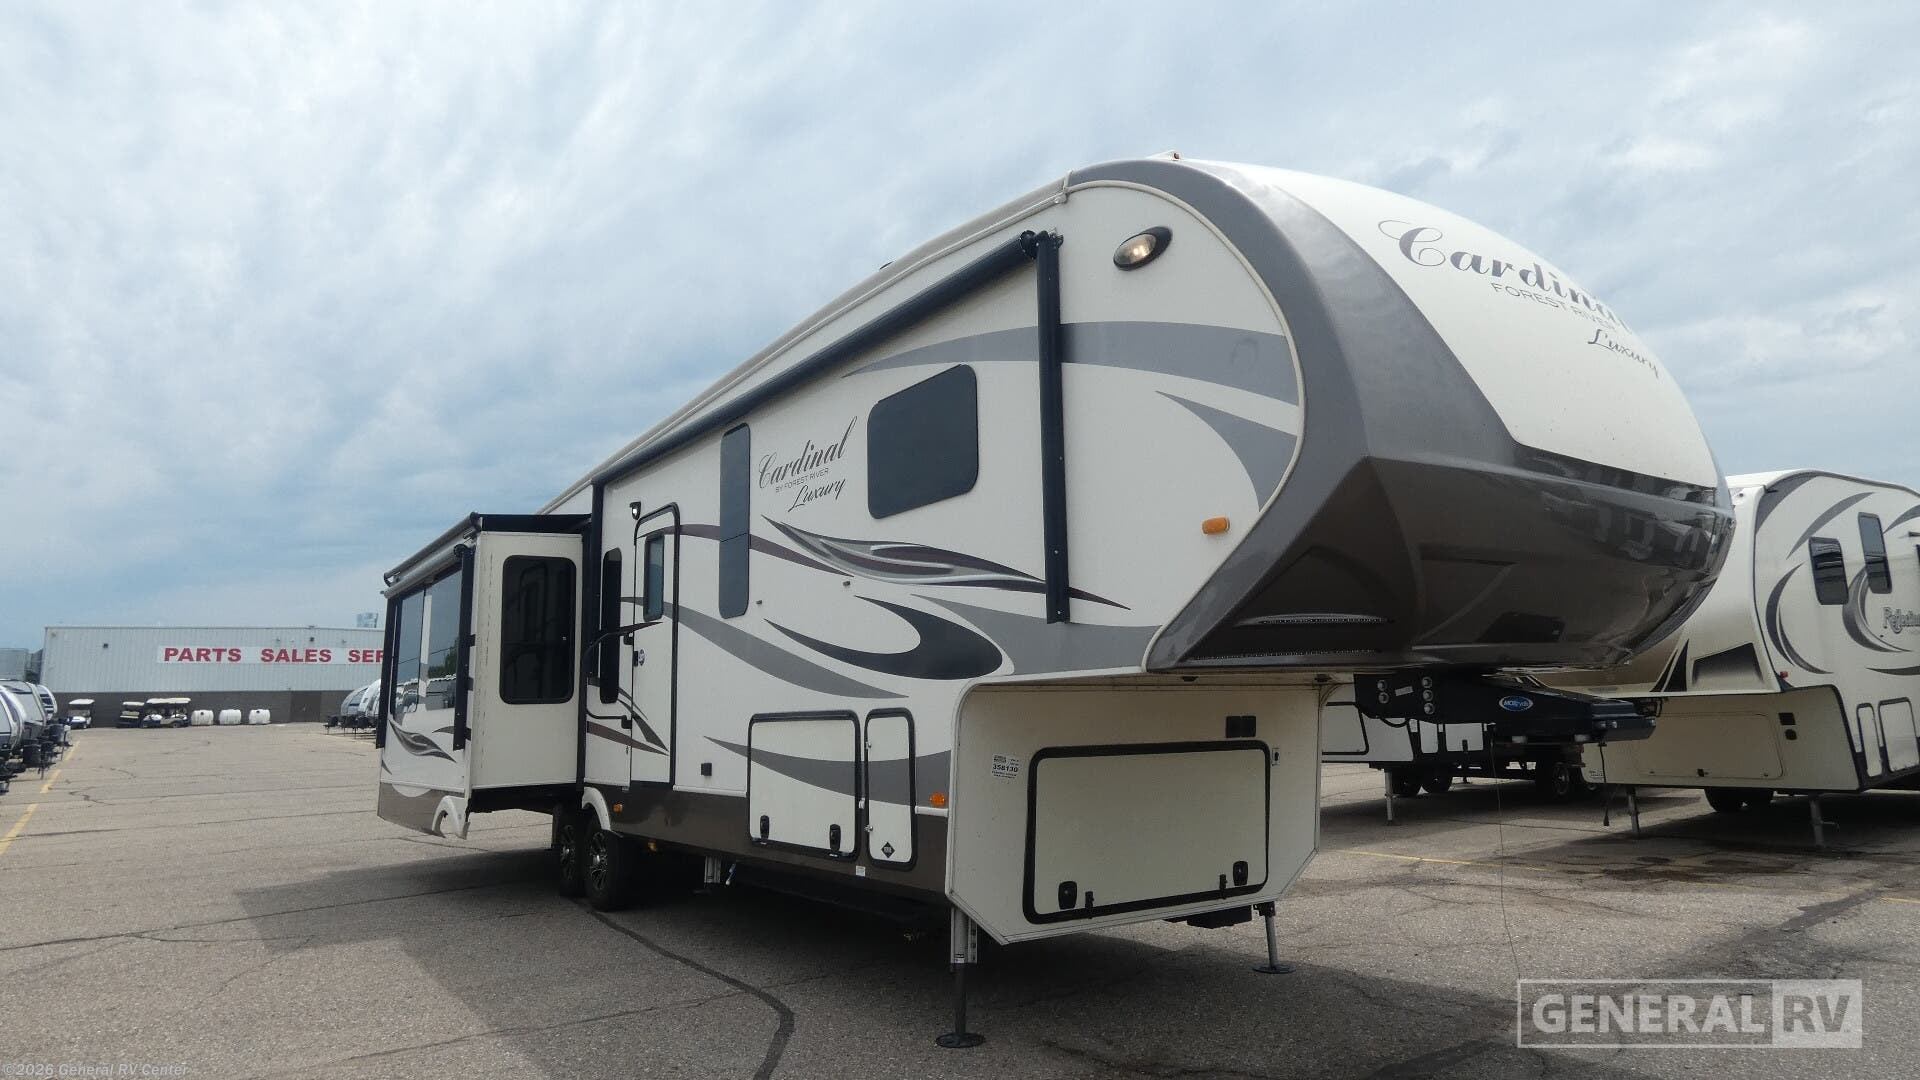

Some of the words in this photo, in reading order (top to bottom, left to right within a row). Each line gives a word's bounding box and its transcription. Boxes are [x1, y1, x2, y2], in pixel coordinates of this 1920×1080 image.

[1491, 282, 1567, 311] FOREST
[1587, 328, 1659, 379] Luxury
[759, 416, 857, 488] Cardinal
[784, 475, 808, 490] FOREST
[809, 467, 829, 480] RIVER
[788, 478, 845, 512] Luxury
[164, 647, 242, 662] PARTS
[260, 648, 332, 663] SALES
